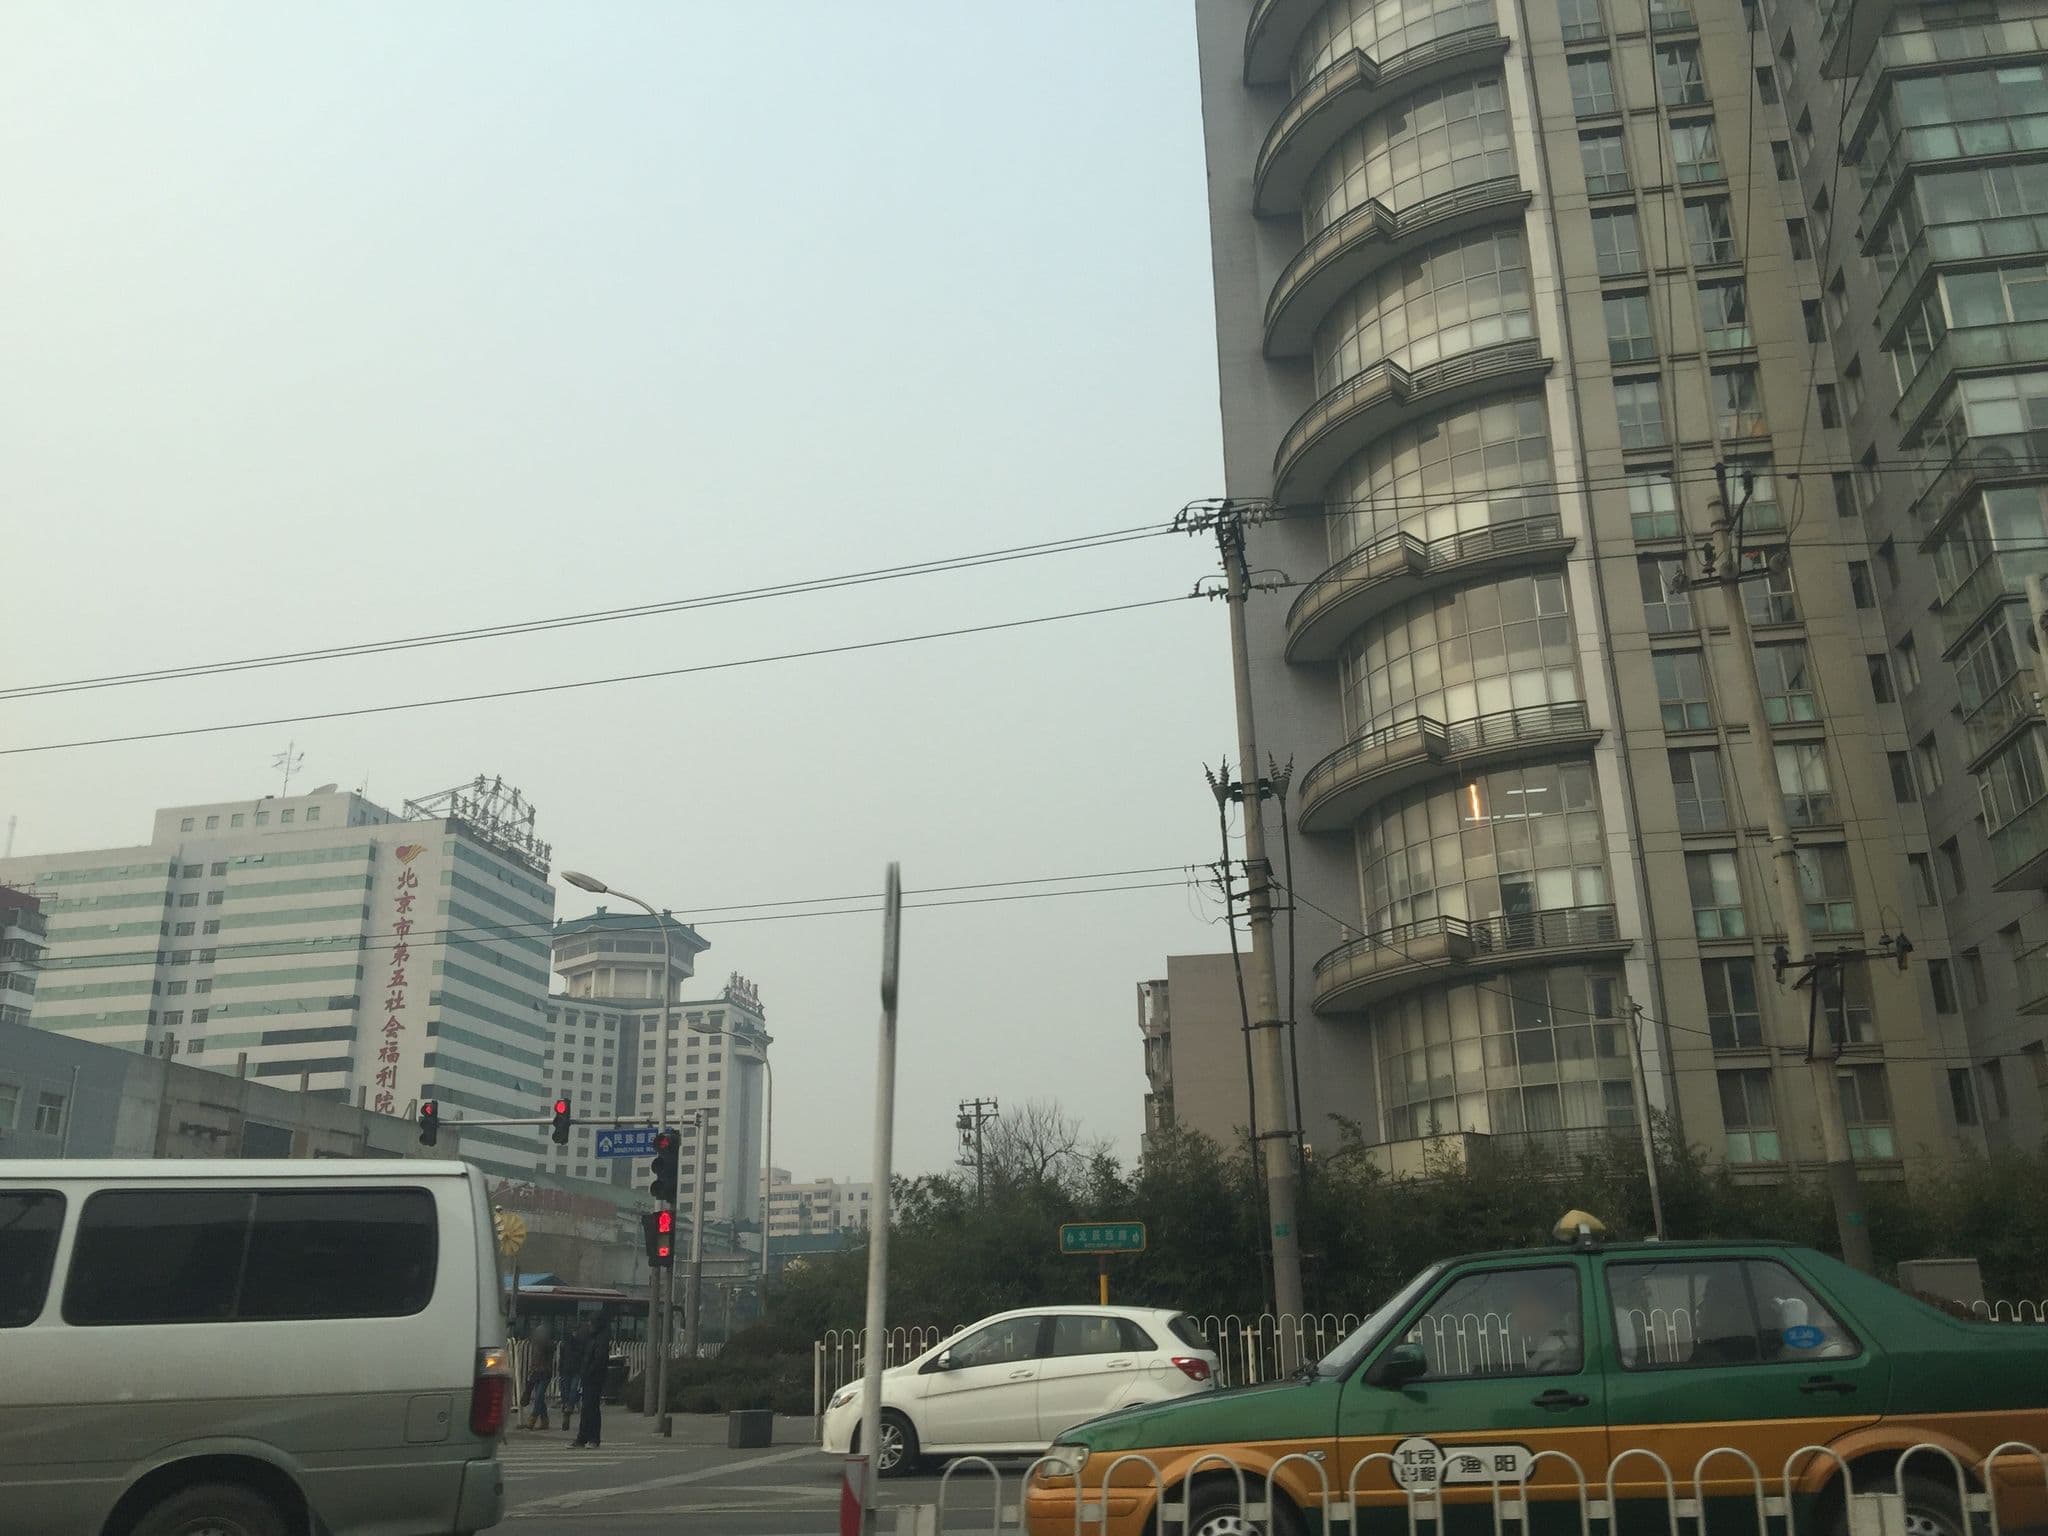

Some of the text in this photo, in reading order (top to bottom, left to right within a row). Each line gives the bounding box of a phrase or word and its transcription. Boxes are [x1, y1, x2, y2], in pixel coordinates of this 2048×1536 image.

[374, 866, 418, 1114] 北京市第五社会福利院
[1399, 1449, 1436, 1465] 北京
[1460, 1454, 1517, 1474] 渔阳
[1399, 1466, 1437, 1482] 出租
